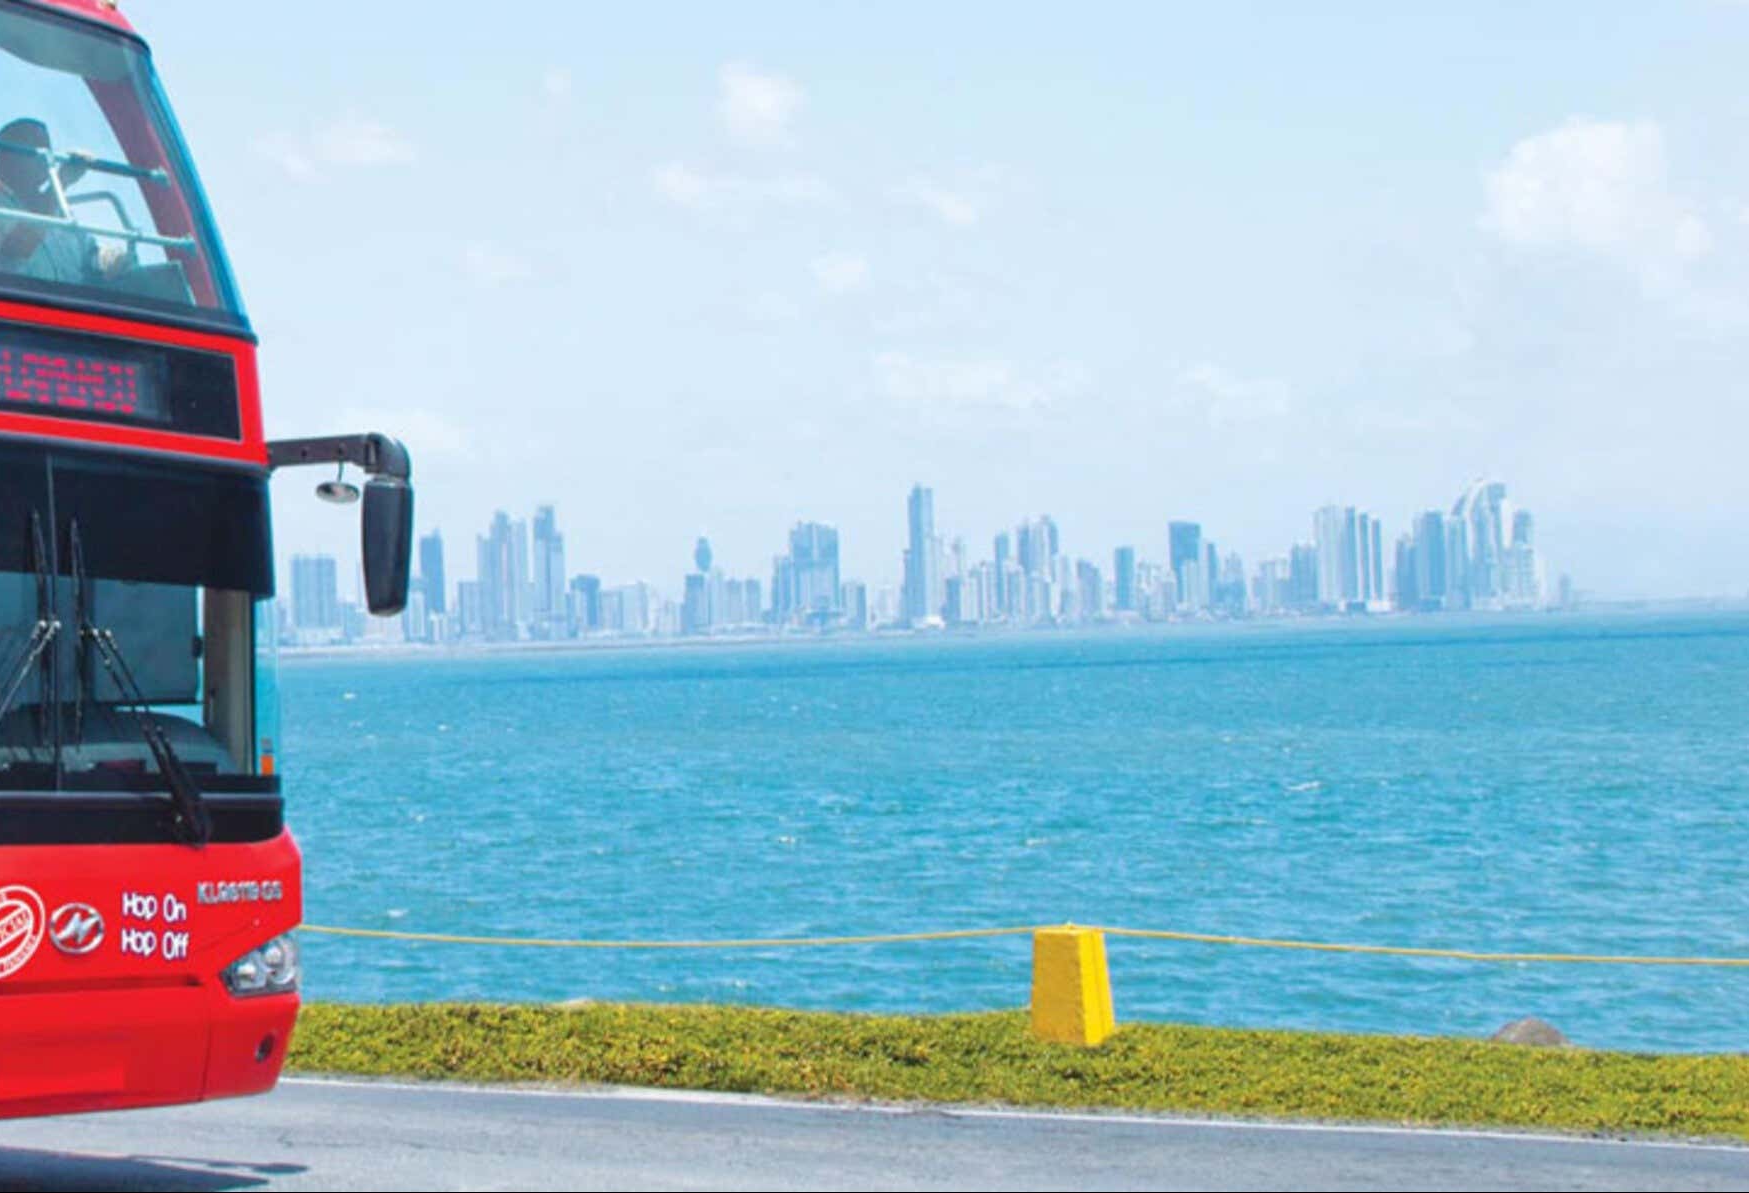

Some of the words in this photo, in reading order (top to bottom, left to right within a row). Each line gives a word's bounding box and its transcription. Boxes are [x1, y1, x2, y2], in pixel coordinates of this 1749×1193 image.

[122, 892, 158, 921] Hop
[162, 892, 187, 923] On
[120, 928, 157, 957] Hop
[161, 930, 190, 961] Off
